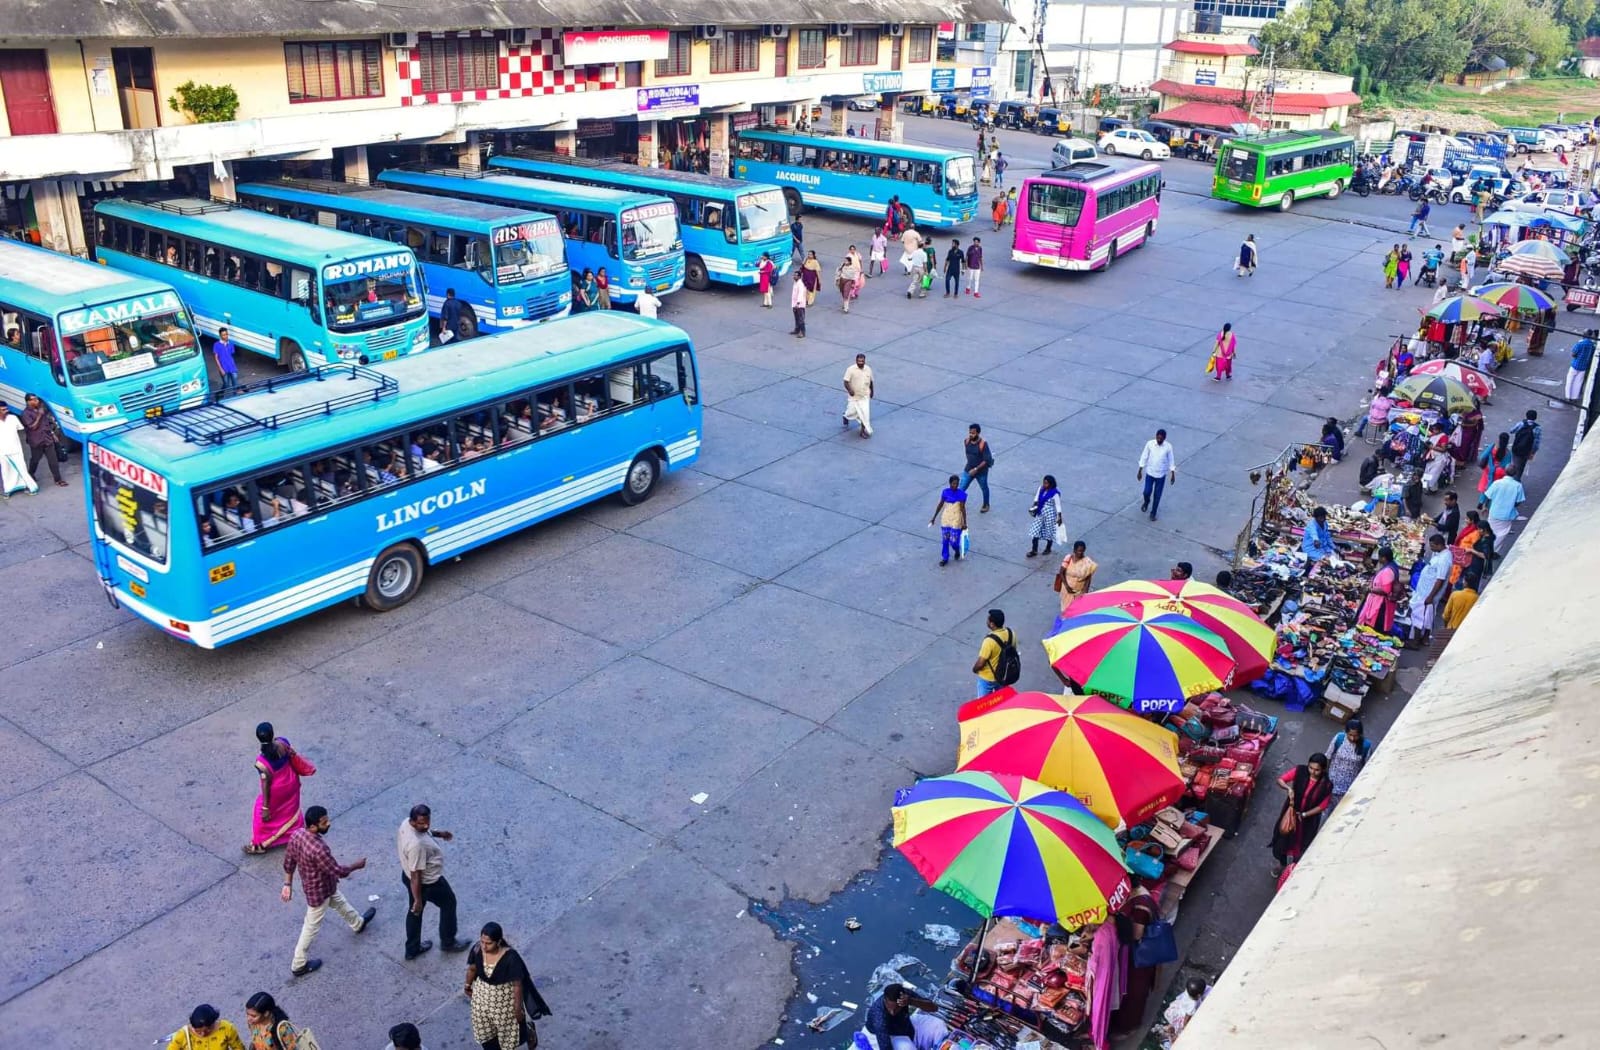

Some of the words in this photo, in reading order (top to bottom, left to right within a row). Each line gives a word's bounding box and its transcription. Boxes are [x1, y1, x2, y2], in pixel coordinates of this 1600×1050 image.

[875, 74, 902, 90] STUDIO
[776, 170, 820, 185] JACQUELIN
[622, 203, 676, 223] SINDHU
[495, 220, 558, 244] AISWARYA
[328, 254, 411, 280] ROMANO
[1567, 291, 1596, 305] HOTEL
[62, 293, 179, 331] KAMALA
[90, 443, 164, 494] LINCOLN
[376, 478, 487, 532] LINCOLN
[1141, 699, 1178, 712] POPY
[1109, 878, 1131, 911] POPY
[1067, 905, 1101, 929] POPY
